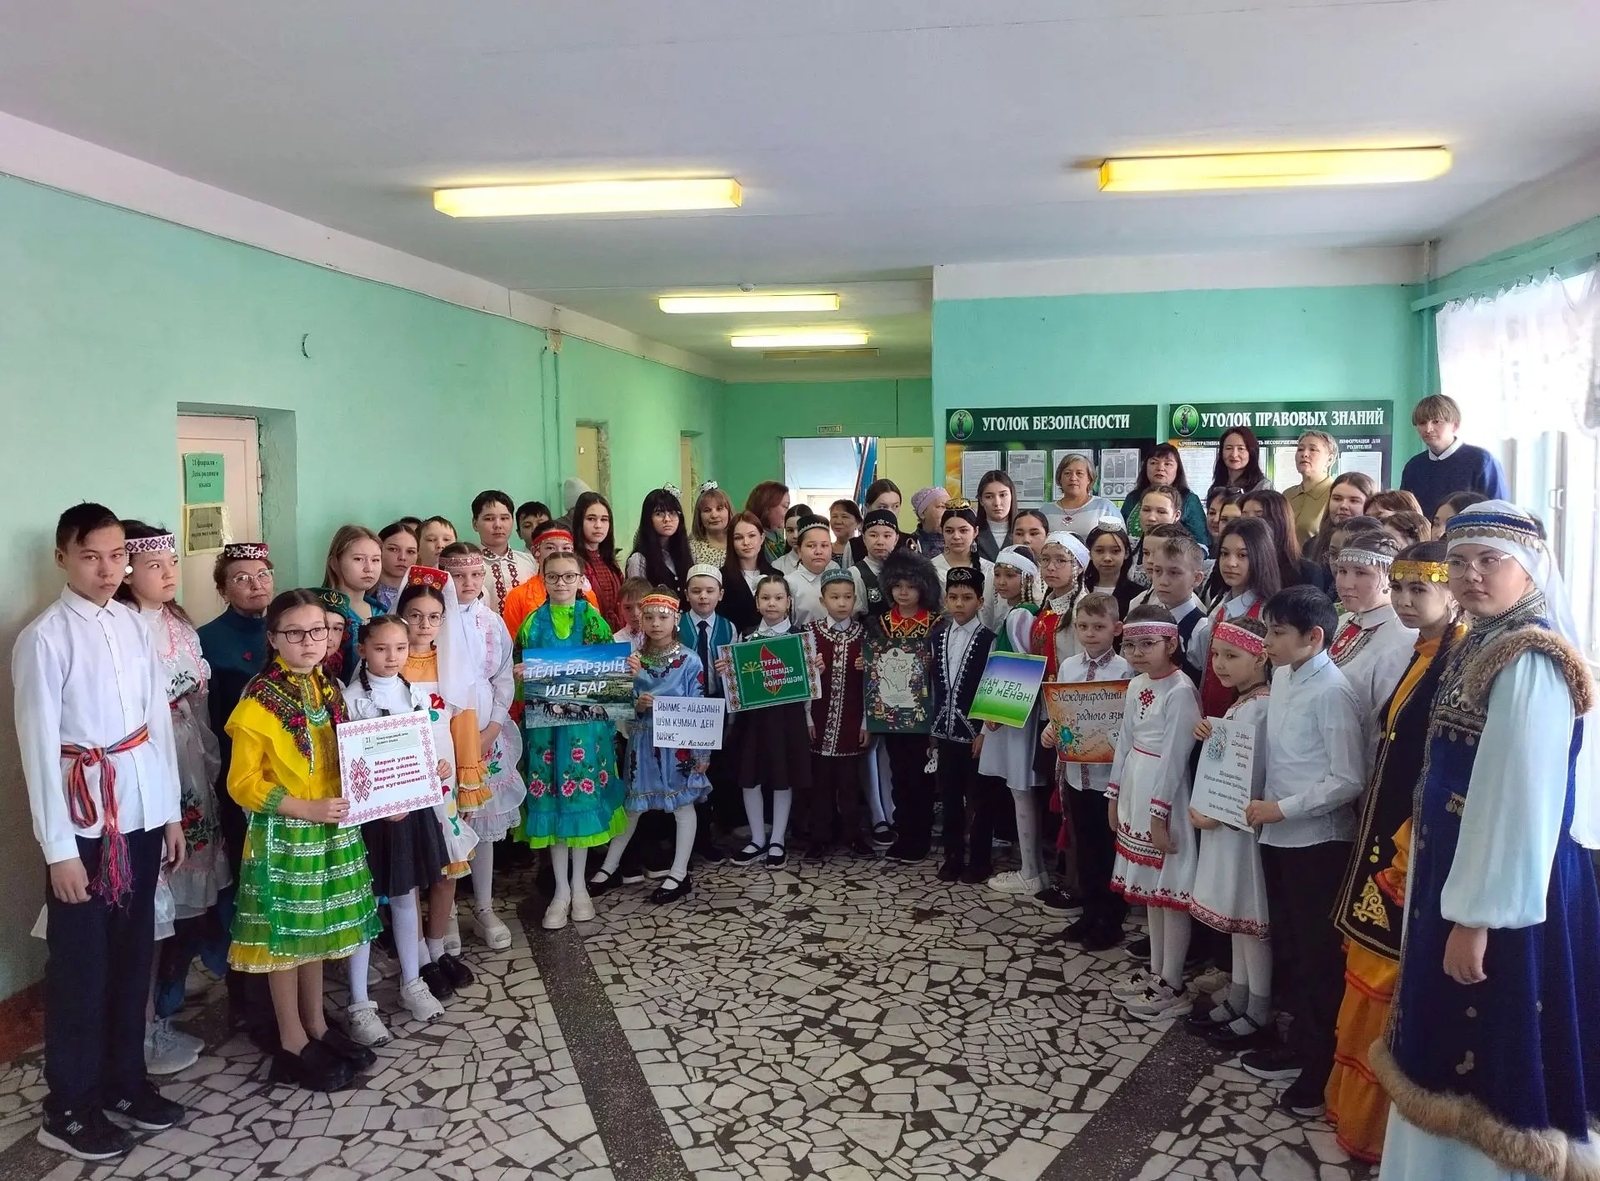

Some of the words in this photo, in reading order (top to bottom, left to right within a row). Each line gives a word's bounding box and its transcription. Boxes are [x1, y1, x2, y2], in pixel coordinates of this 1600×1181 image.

[982, 416, 1030, 431] УГОЛОК
[1032, 414, 1130, 430] БЕЗОПАСНОСТИ
[1201, 412, 1252, 428] УГОЛОК
[1255, 411, 1328, 426] ПРАВОВЫХ
[1330, 407, 1384, 426] ЗНАНИЙ
[527, 664, 562, 678] ТЕЛЕ
[545, 683, 575, 697] ИЛЕ
[578, 681, 606, 694] БАР
[1002, 680, 1022, 692] ТЕЛ
[996, 689, 1034, 703] МЕНӘН!
[1051, 688, 1122, 706] Международный
[1076, 709, 1107, 724] родного
[1109, 712, 1124, 724] язы
[700, 720, 714, 729] ДЕН
[374, 758, 395, 766] Марий
[374, 774, 395, 782] Марий
